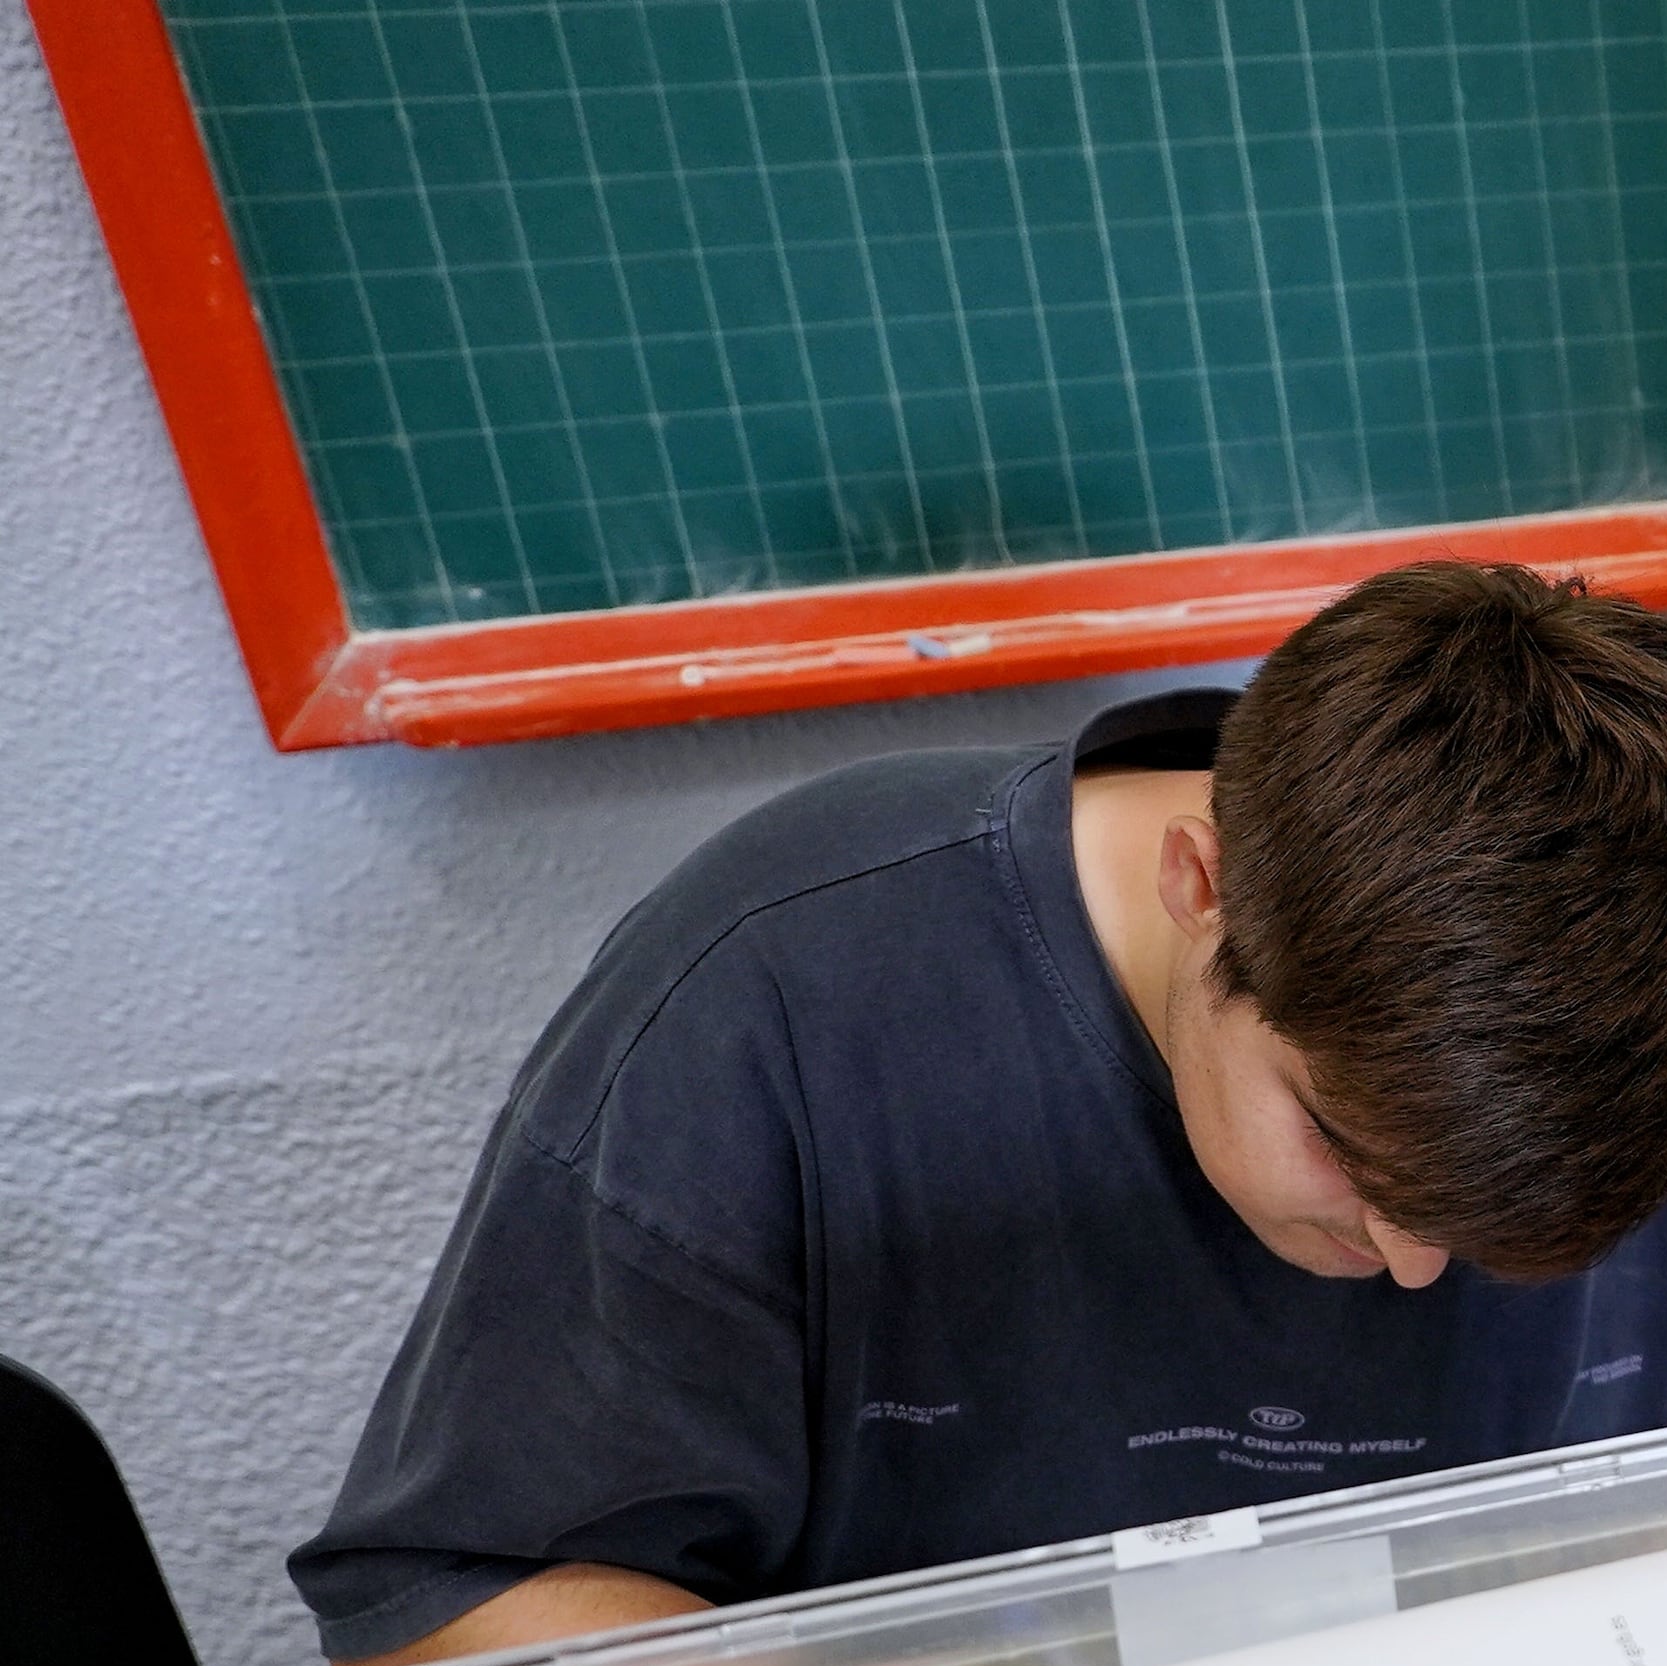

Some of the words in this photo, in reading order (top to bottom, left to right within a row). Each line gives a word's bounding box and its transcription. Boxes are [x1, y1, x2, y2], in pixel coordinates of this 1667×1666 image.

[1129, 1426, 1237, 1448] ENDLESSLY
[1242, 1435, 1343, 1453] CREATING
[1350, 1438, 1427, 1454] MYSELF
[1232, 1454, 1264, 1470] COLD
[1267, 1462, 1324, 1471] CULTURE
